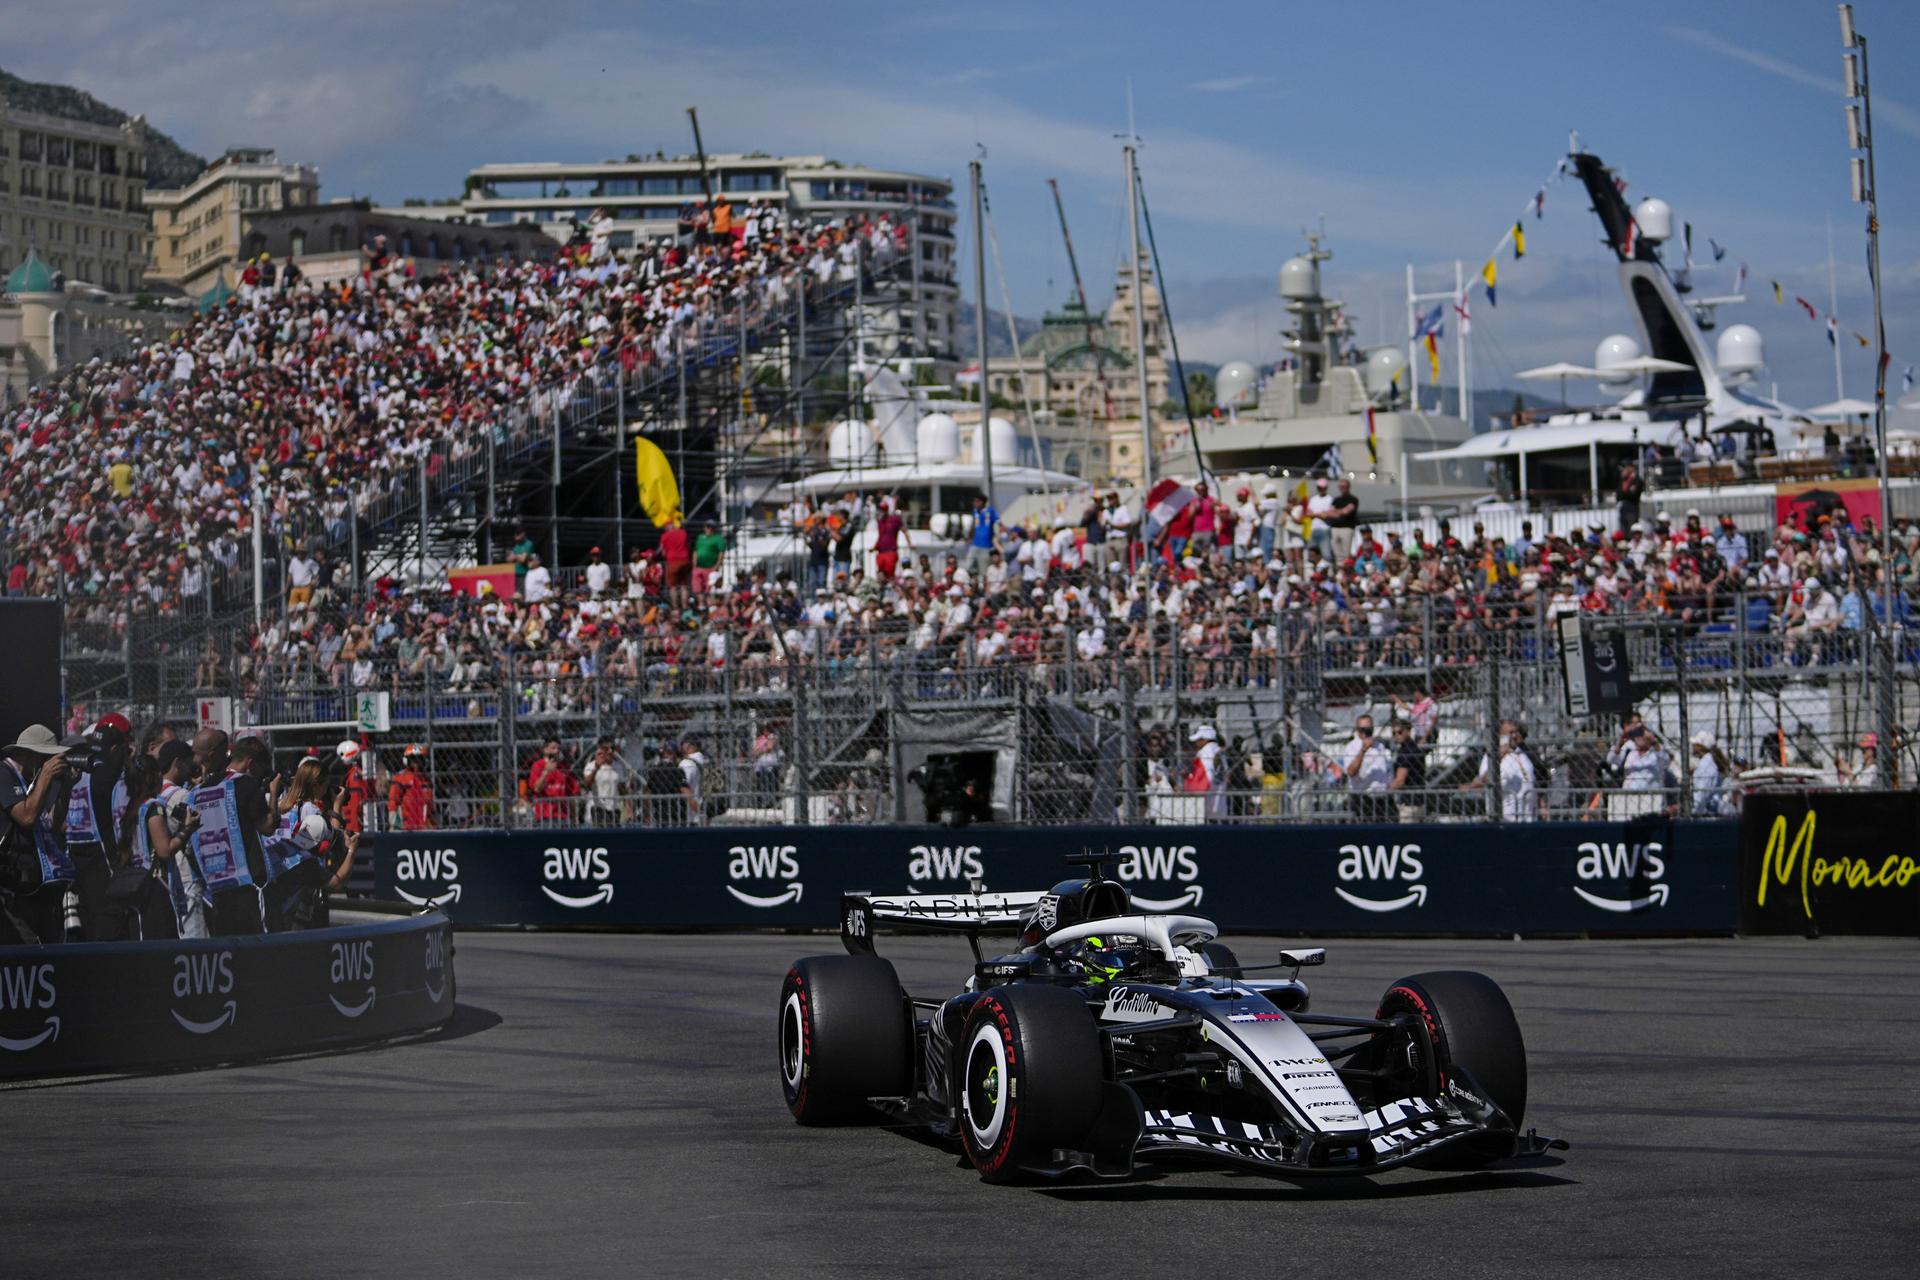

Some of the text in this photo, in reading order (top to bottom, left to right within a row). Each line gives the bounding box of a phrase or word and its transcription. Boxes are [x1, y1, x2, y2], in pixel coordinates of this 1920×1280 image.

[396, 848, 459, 881] aws
[543, 847, 610, 881] aws
[728, 845, 800, 880] aws
[908, 845, 984, 881] aws
[1118, 845, 1199, 881] aws
[1337, 843, 1424, 880] aws
[1577, 842, 1665, 880] aws
[1758, 809, 1920, 919] Monaco
[331, 940, 374, 984] aws
[425, 930, 444, 970] aws
[0, 963, 56, 1010] ws
[173, 951, 234, 998] aws
[1109, 986, 1160, 1015] Cadillac
[991, 1002, 1017, 1065] ZERO
[1282, 1070, 1336, 1081] PIRELLI
